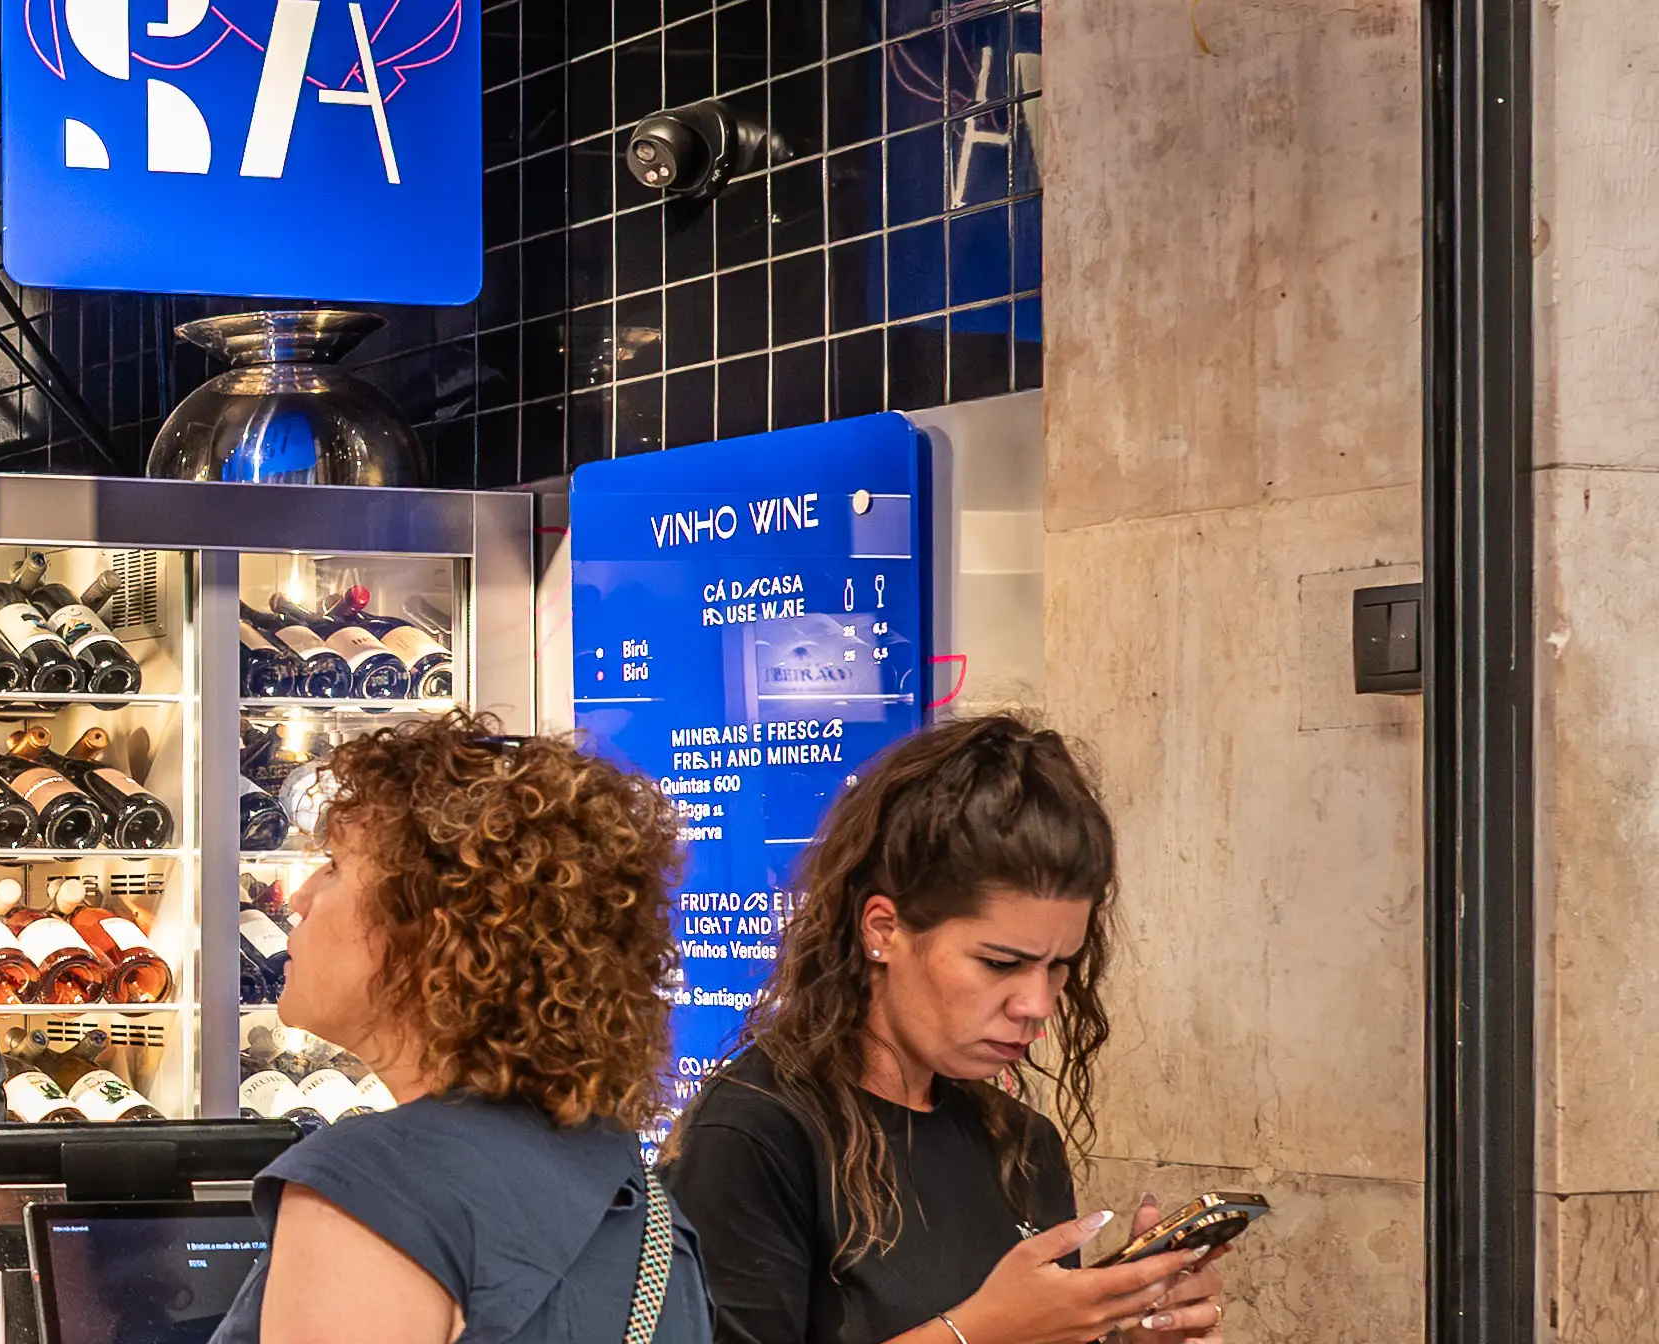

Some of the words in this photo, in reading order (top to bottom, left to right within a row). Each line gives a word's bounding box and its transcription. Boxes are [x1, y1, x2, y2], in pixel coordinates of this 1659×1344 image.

[651, 506, 736, 548] VINHO
[749, 493, 818, 534] WINE
[753, 724, 761, 742] E
[727, 748, 761, 767] AND
[714, 775, 740, 792] 600
[737, 917, 772, 934] AND
[683, 940, 727, 958] Vinhos
